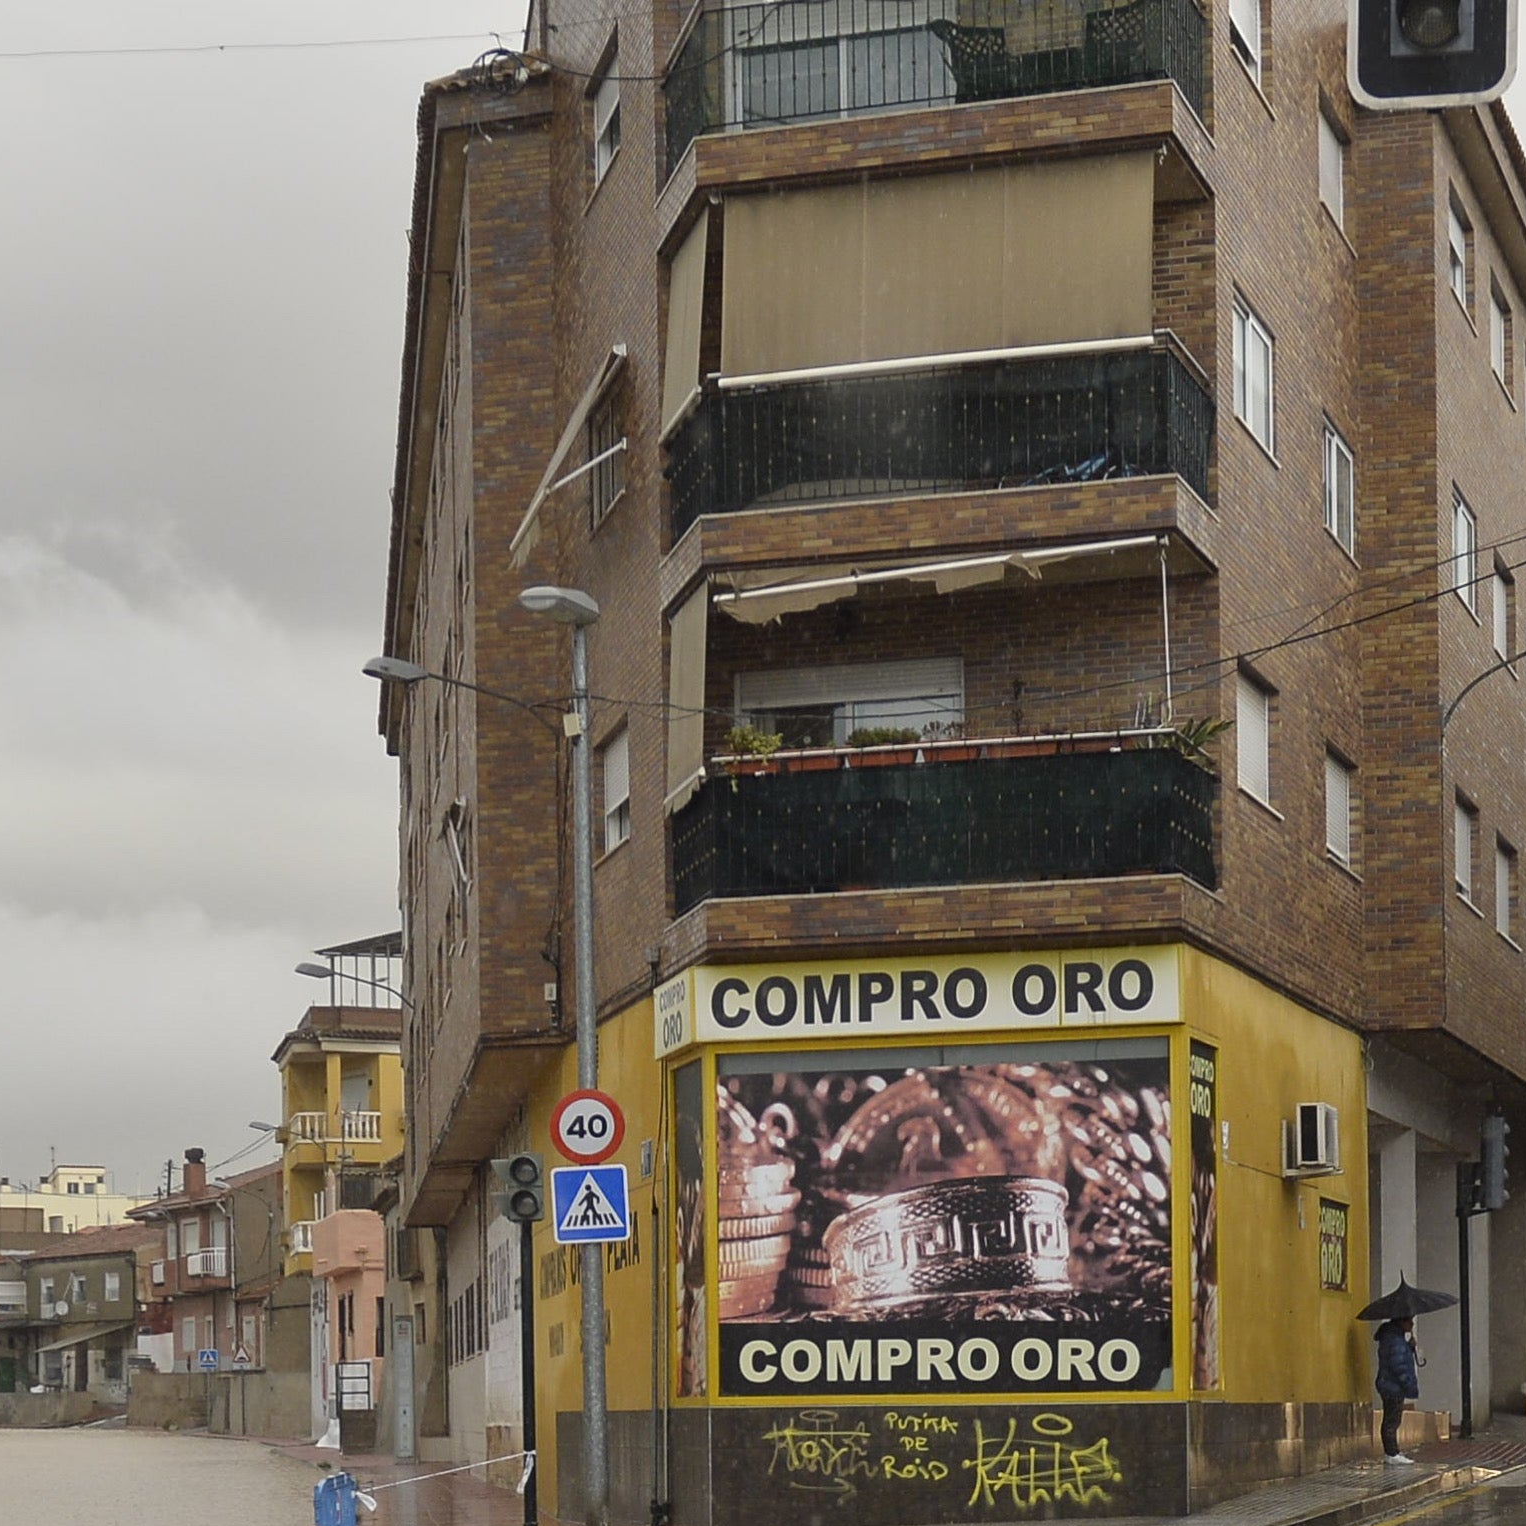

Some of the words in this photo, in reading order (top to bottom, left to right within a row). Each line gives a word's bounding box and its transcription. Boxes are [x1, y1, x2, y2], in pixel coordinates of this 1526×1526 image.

[659, 979, 686, 1013] COMPRO
[711, 966, 988, 1029] COMPRO
[1011, 959, 1155, 1016] ORO
[662, 1010, 683, 1050] ORO
[1191, 1082, 1211, 1118] ORO
[566, 1113, 608, 1139] 40
[1321, 1242, 1342, 1285] ORO
[738, 1337, 1001, 1384] COMPRO
[1010, 1337, 1142, 1383] ORO
[899, 1436, 930, 1452] DE
